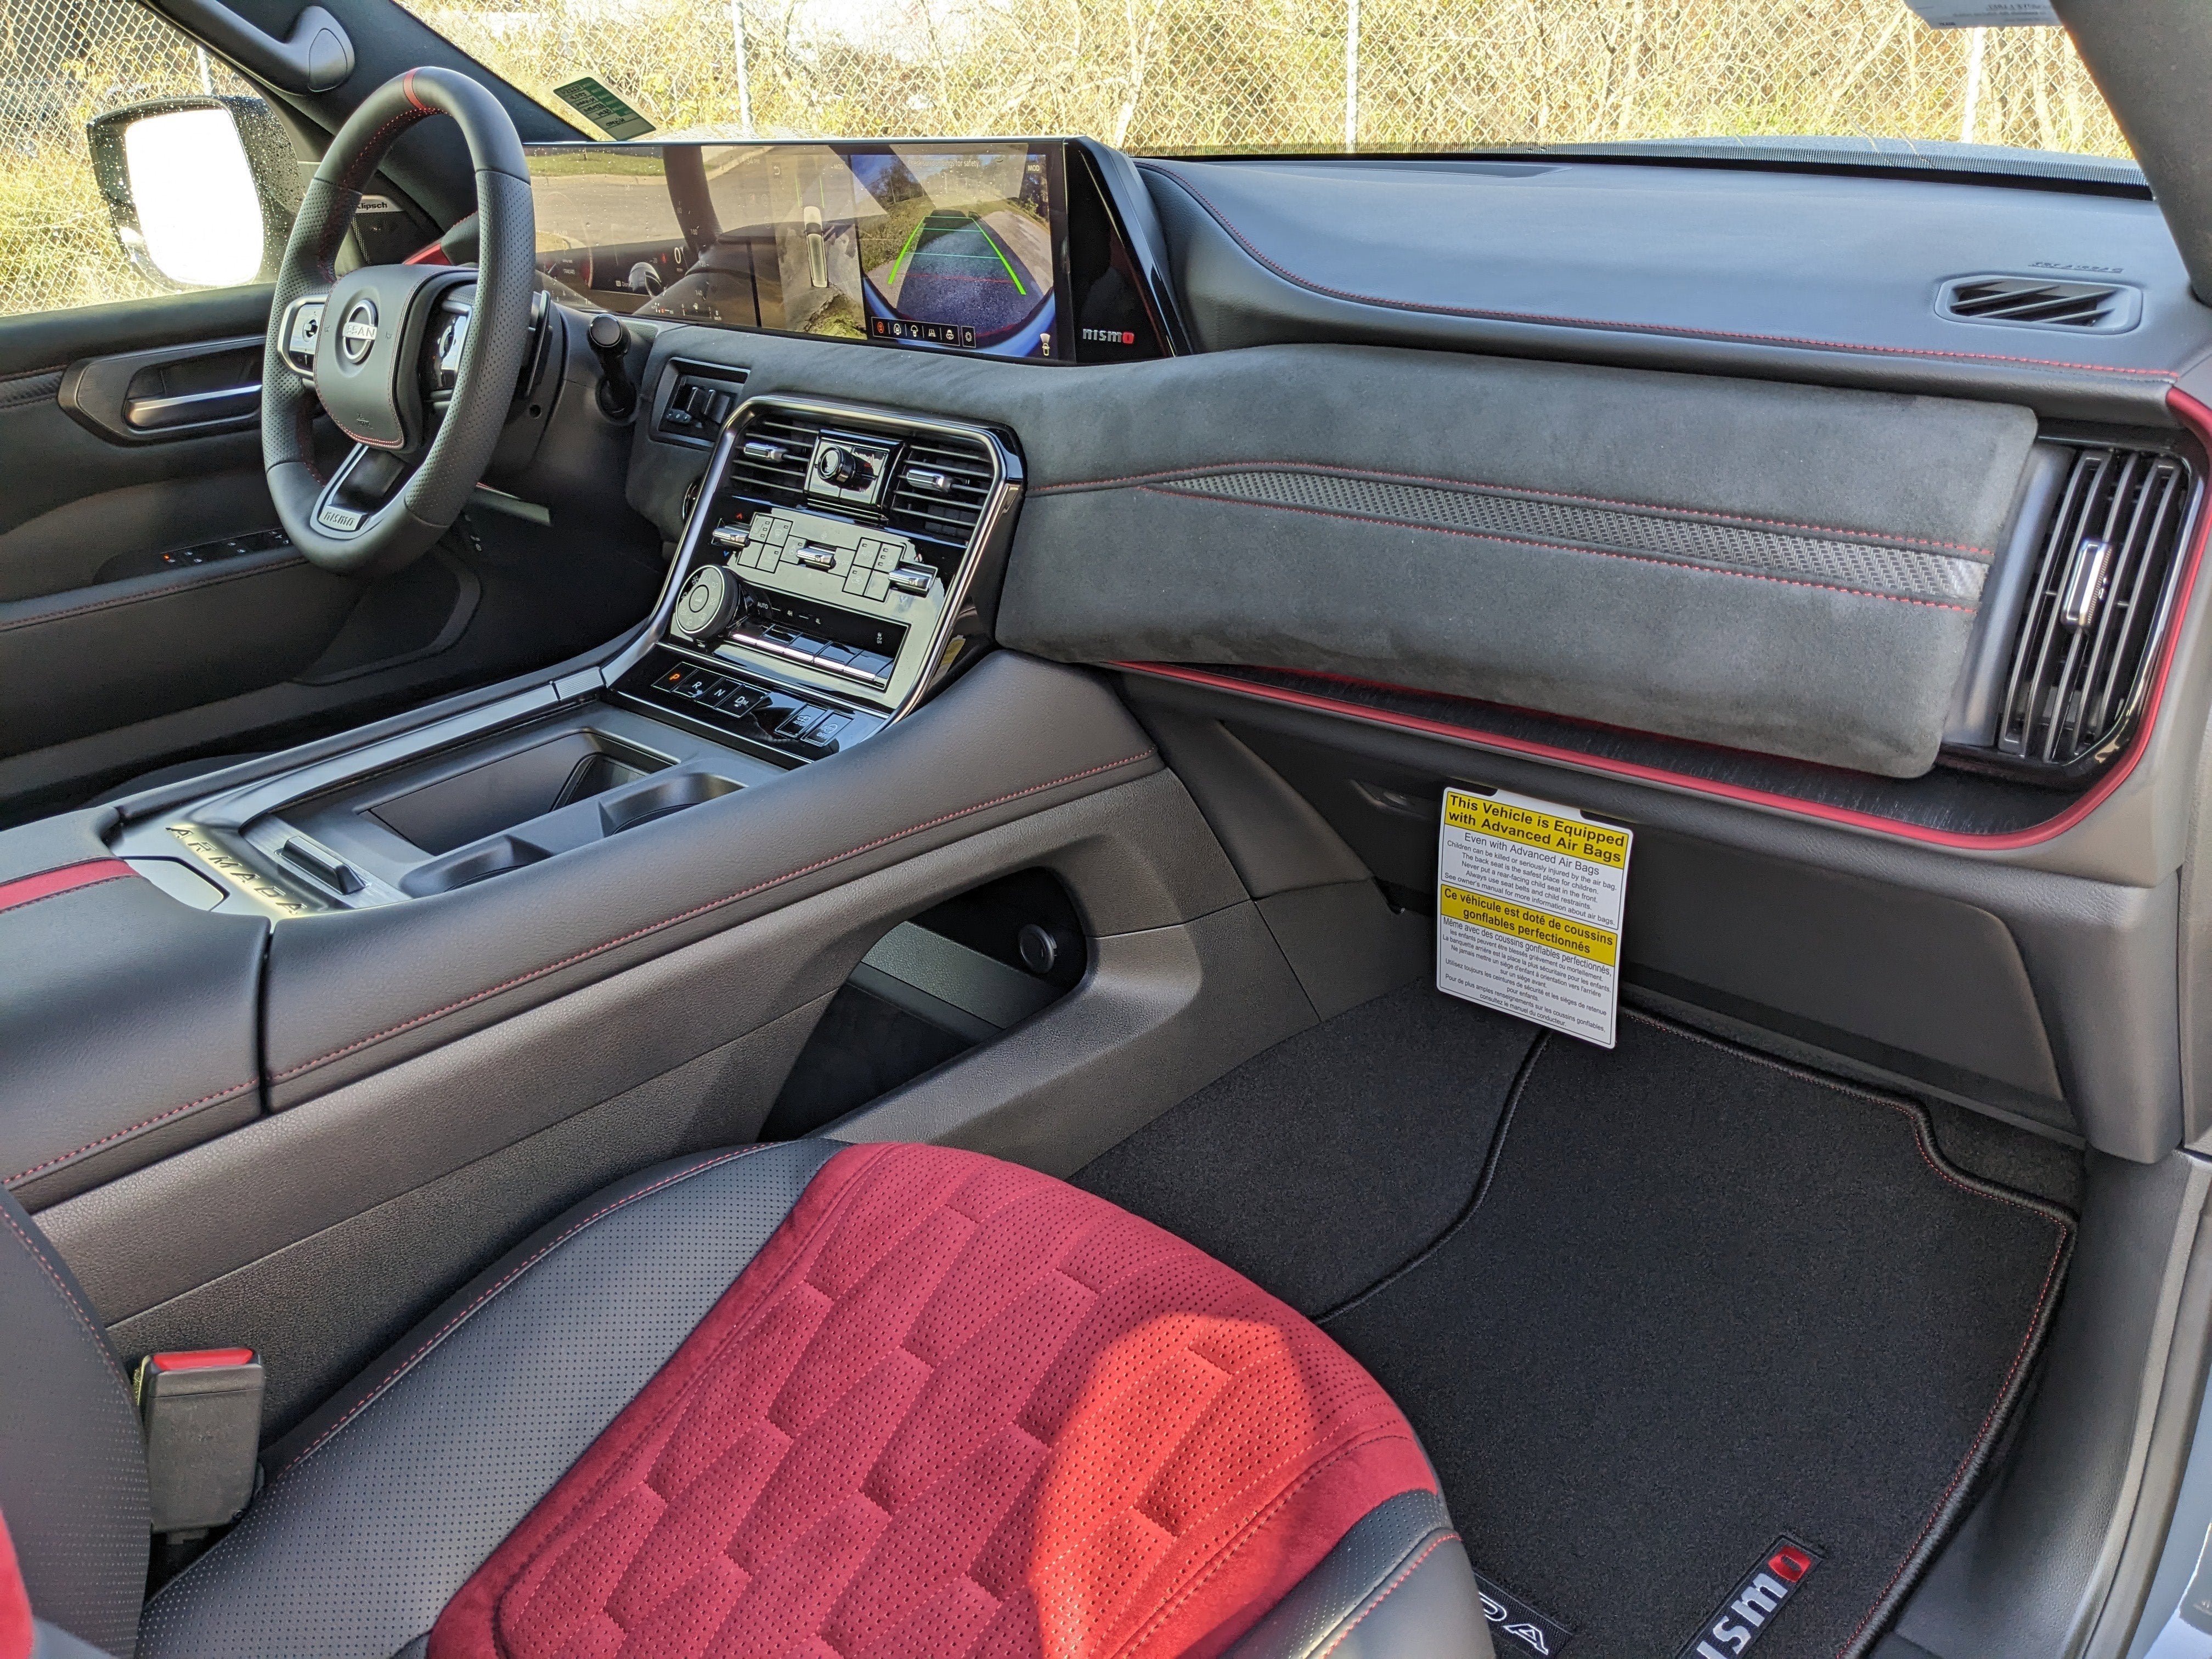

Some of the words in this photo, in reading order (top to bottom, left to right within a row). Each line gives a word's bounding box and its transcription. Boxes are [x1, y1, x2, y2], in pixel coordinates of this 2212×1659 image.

[963, 159, 980, 168] safety.
[674, 247, 682, 264] 0
[343, 324, 376, 338] SSAN
[1082, 329, 1135, 344] nismo
[692, 681, 703, 689] R
[714, 689, 726, 697] N
[1448, 811, 1476, 826] with
[1480, 817, 1551, 845] Advanced
[1555, 837, 1578, 851] Air
[1583, 842, 1621, 863] Bags
[1449, 794, 1478, 811] This
[1482, 802, 1533, 825] Vehicle
[1537, 815, 1549, 828] is
[1554, 819, 1625, 847] Equipped
[165, 826, 308, 916] ARMADA
[1447, 839, 1471, 852] Children
[1484, 849, 1493, 857] be
[1493, 851, 1510, 862] killed
[1519, 860, 1547, 873] seriously
[1548, 866, 1570, 878] injured
[1571, 872, 1579, 882] by
[1580, 874, 1591, 883] the
[1462, 851, 1474, 861] The
[1474, 855, 1489, 865] back
[1490, 861, 1504, 869] seat
[1504, 862, 1510, 871] is
[1511, 865, 1522, 873] the
[1522, 869, 1542, 879] safest
[1542, 874, 1560, 884] place
[1561, 878, 1571, 887] for
[1464, 832, 1487, 846] Even
[1489, 840, 1508, 851] with
[1509, 844, 1556, 864] Advanced
[1558, 856, 1573, 868] Air
[1574, 860, 1599, 876] Bags
[1444, 872, 1457, 881] See
[1481, 883, 1504, 894] manual
[1504, 888, 1514, 896] for
[1514, 892, 1531, 901] more
[1531, 896, 1566, 912] information
[1567, 907, 1586, 917] about
[1461, 860, 1480, 871] Never
[1530, 879, 1546, 889] child
[1547, 884, 1561, 893] seat
[1561, 887, 1568, 895] in
[1569, 889, 1580, 898] the
[1465, 870, 1487, 882] Always
[1500, 880, 1514, 889] seat
[1515, 883, 1530, 893] belts
[1531, 889, 1543, 897] and
[1544, 891, 1560, 901] child
[1444, 888, 1457, 900] Ce
[1459, 894, 1502, 913] véhicule
[1504, 906, 1520, 918] est
[1522, 910, 1545, 926] doté
[1548, 918, 1561, 930] de
[1564, 924, 1613, 946] coussins
[1463, 909, 1515, 931] gonflables
[1517, 924, 1590, 953] perfectionnés
[1443, 916, 1463, 930] Même
[1464, 924, 1480, 935] avec
[1481, 928, 1493, 939] des
[1494, 933, 1523, 949] coussins
[1525, 943, 1560, 960] gonflables
[1561, 954, 1613, 978] perfectionnés,
